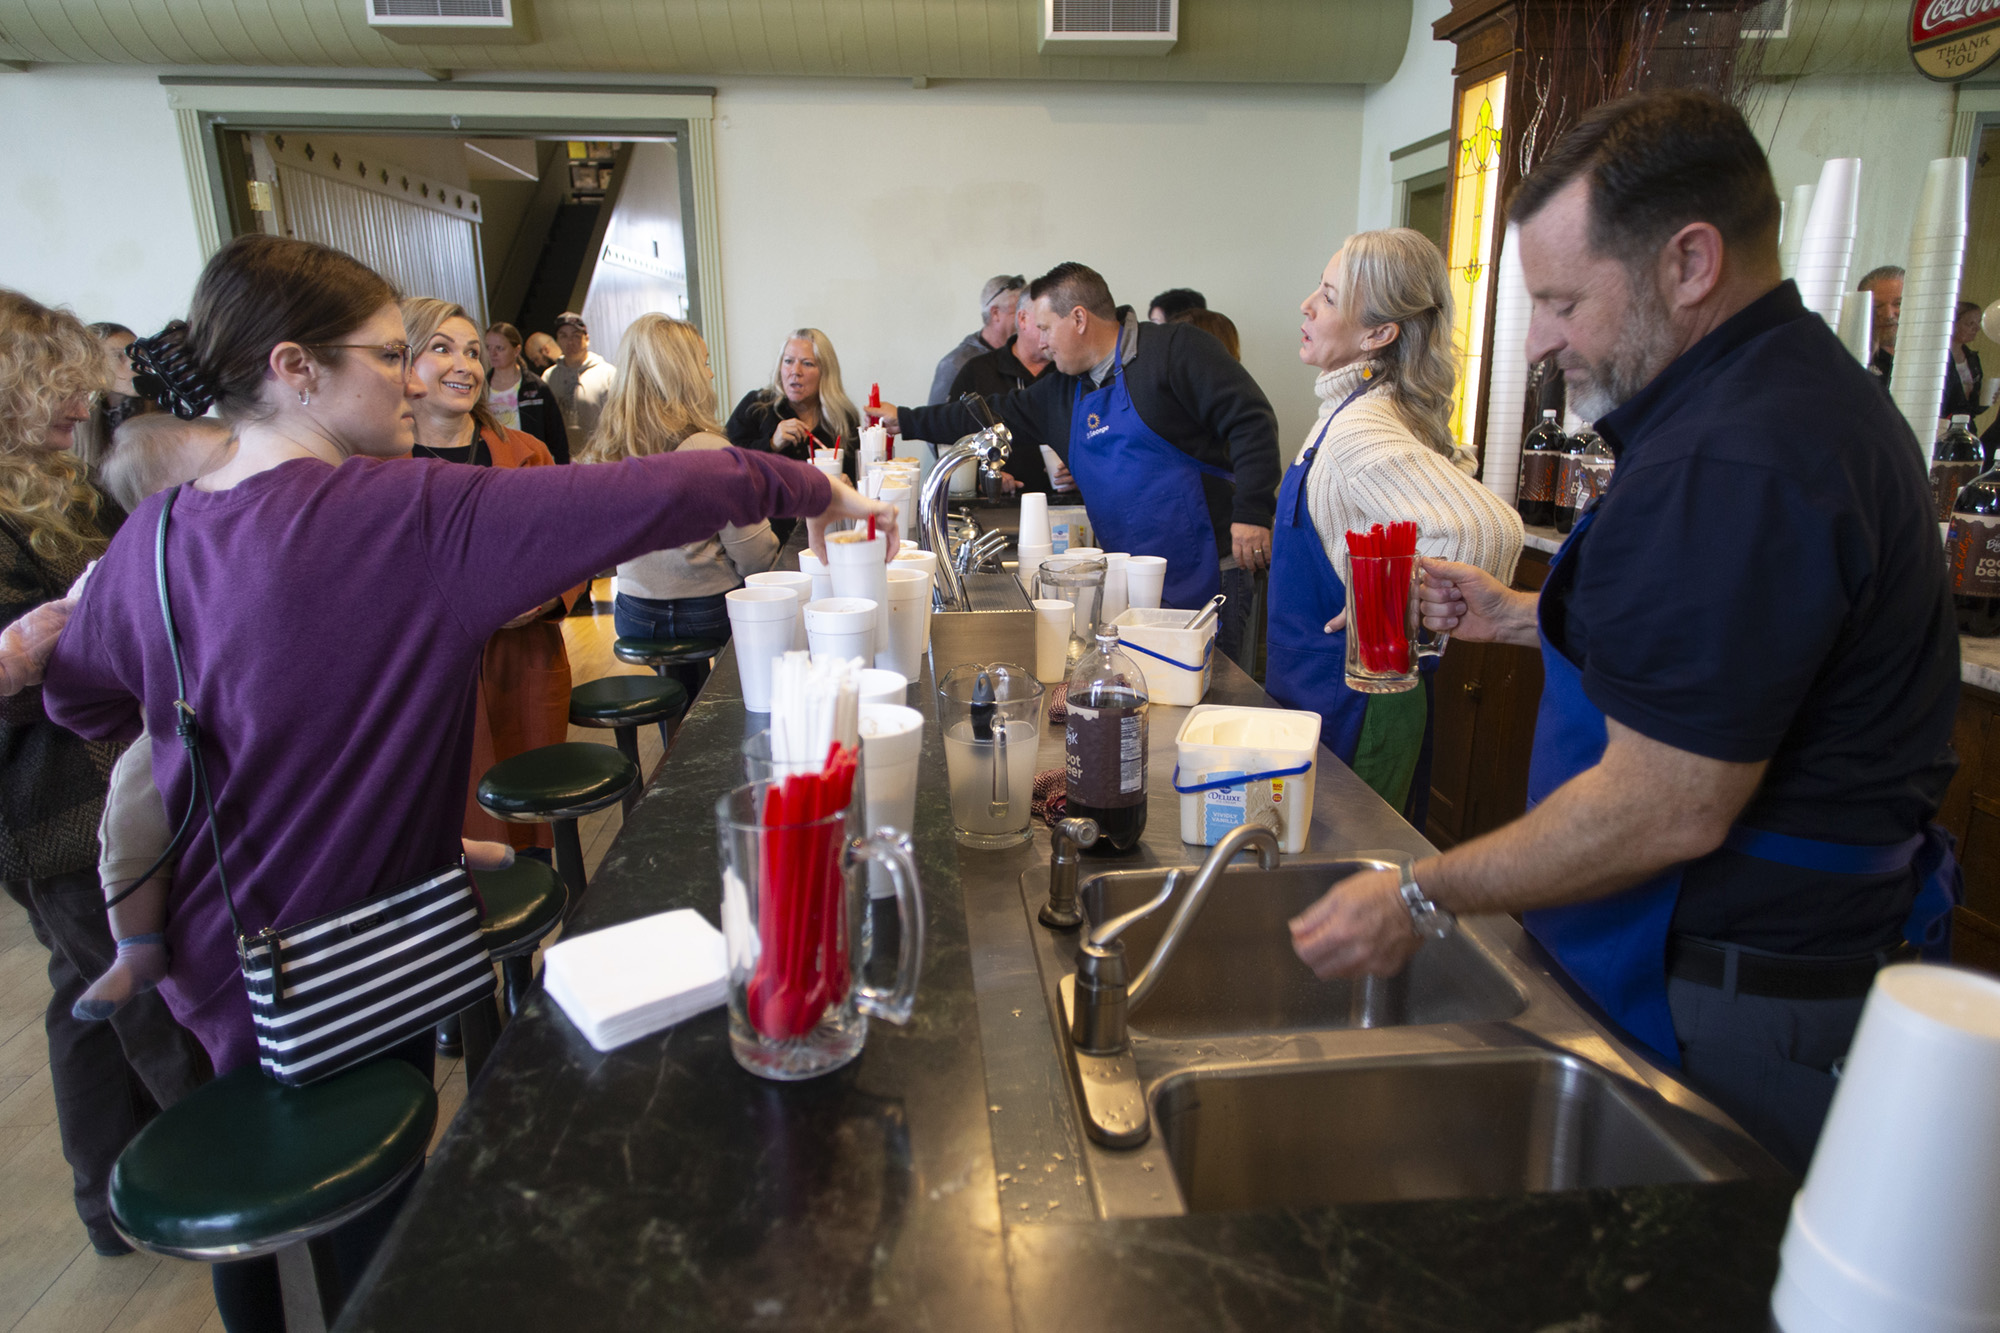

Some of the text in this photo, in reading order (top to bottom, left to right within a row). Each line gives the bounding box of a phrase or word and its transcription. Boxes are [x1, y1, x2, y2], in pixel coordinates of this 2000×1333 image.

[1936, 35, 1990, 59] THANK
[1946, 51, 1977, 68] YOU
[1208, 792, 1240, 802] DELUXE
